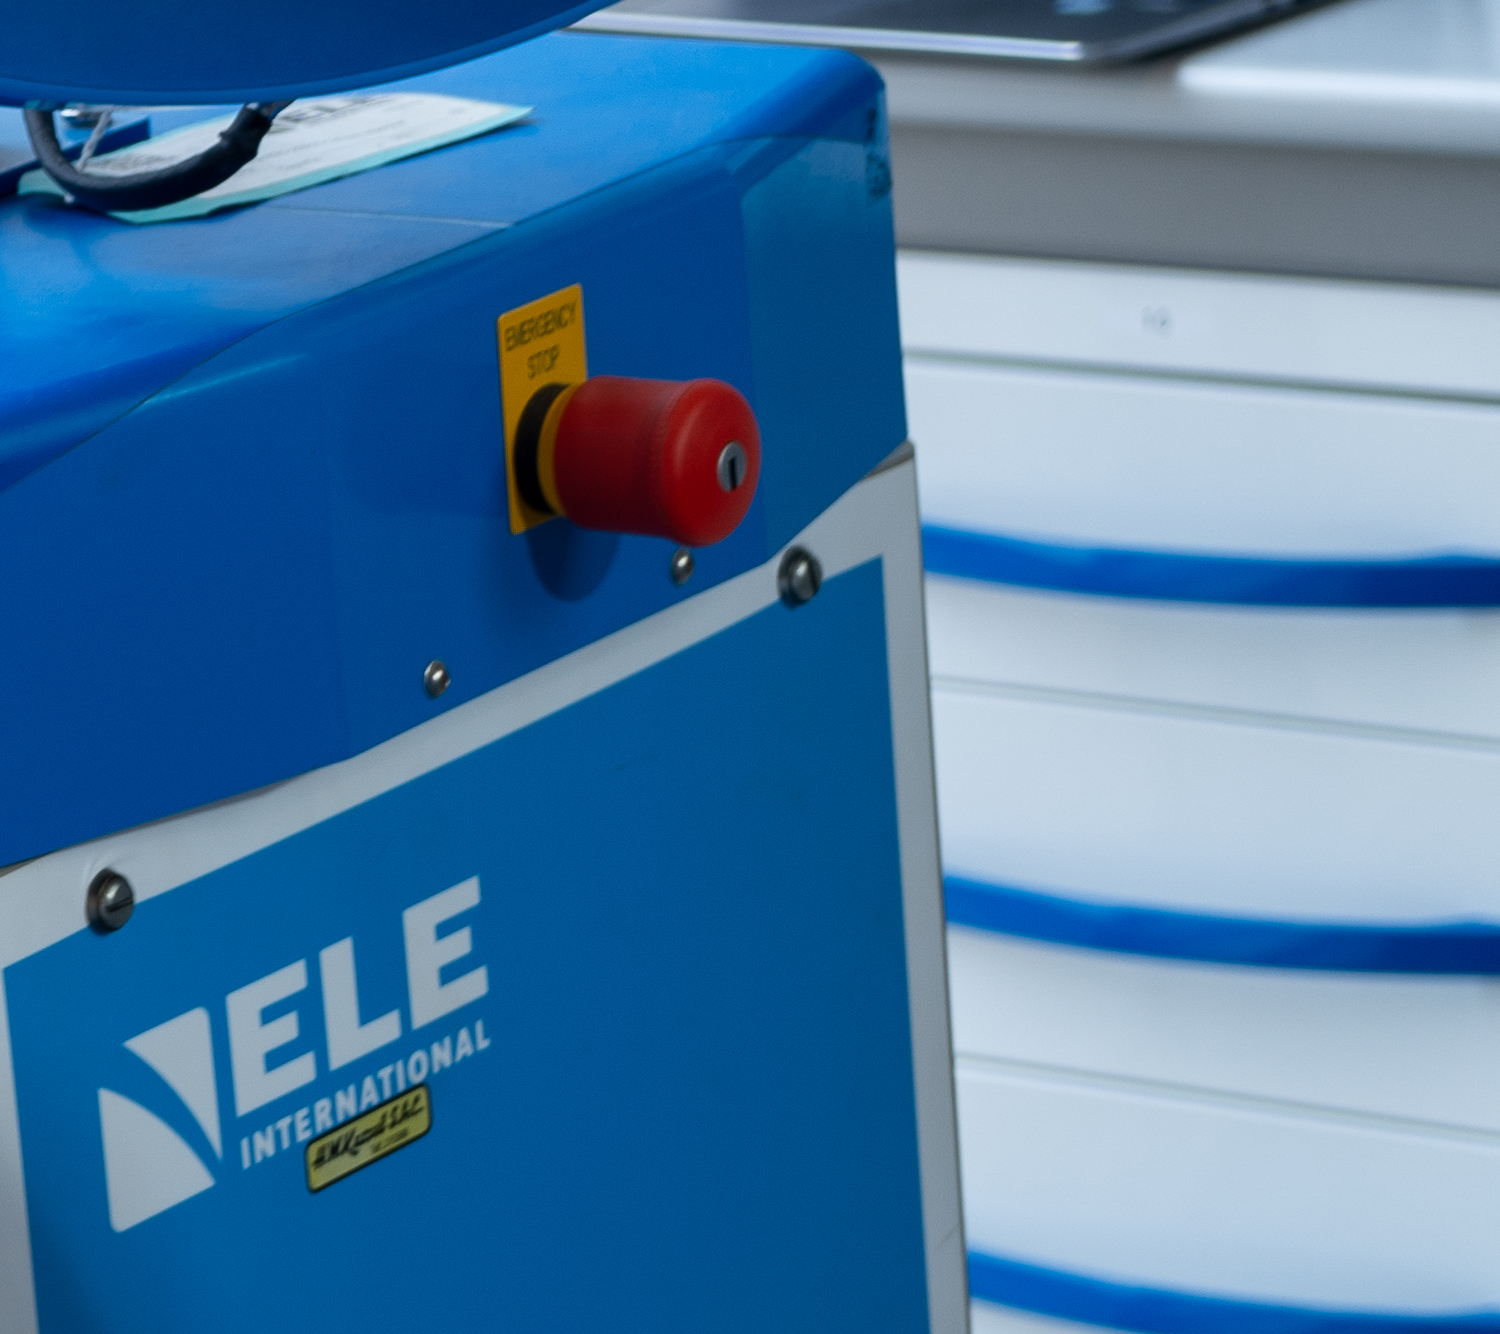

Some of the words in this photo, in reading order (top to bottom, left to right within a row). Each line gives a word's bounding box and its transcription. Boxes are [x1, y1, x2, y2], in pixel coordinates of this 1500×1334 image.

[505, 297, 580, 353] EMERGENCY
[526, 345, 560, 380] STOP
[225, 874, 490, 1118] ELE
[239, 1018, 492, 1170] INTERNATIONAL
